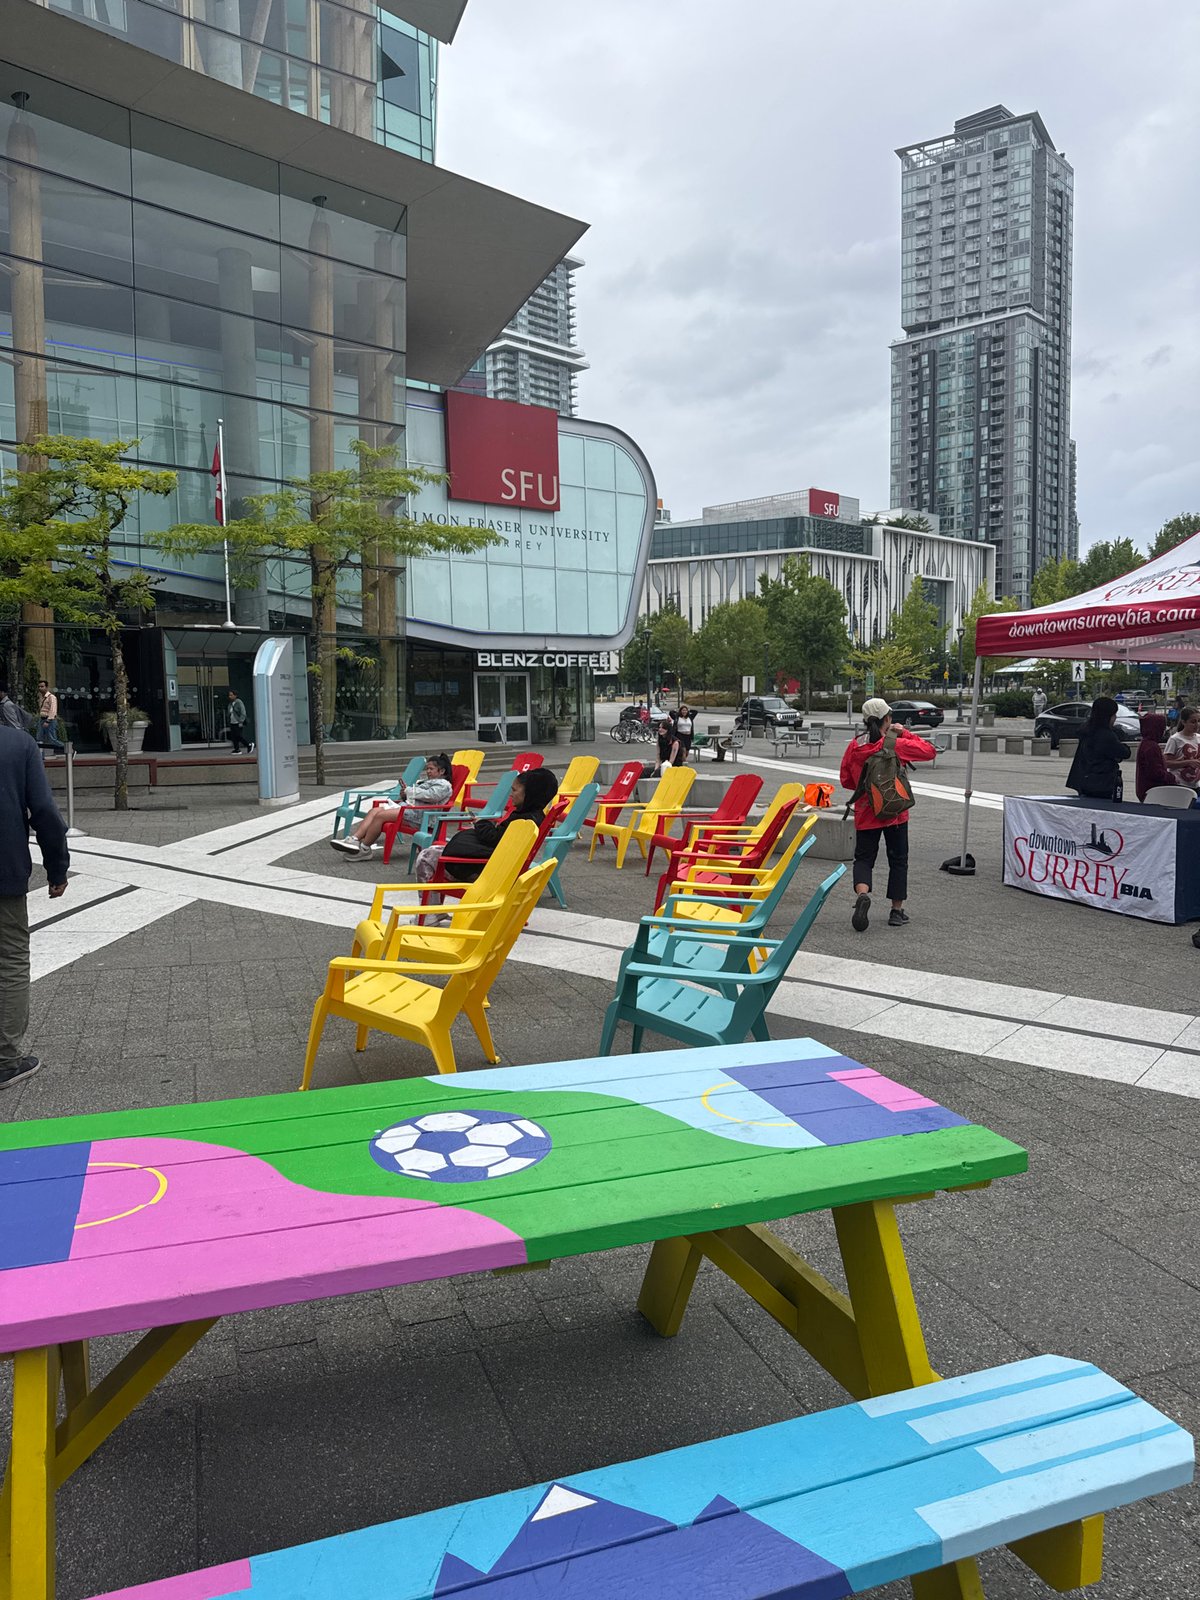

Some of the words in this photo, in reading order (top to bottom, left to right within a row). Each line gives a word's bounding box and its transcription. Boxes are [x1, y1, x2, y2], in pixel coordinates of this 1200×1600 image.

[501, 468, 558, 505] SFU
[823, 502, 840, 517] SFU
[402, 510, 460, 526] SIMON
[468, 516, 521, 534] FRASER
[529, 524, 610, 542] UNIVERSITY
[1008, 607, 1197, 638] downtownsurreybia.com
[477, 652, 539, 667] BLENZ
[1029, 829, 1077, 856] downtown
[1014, 836, 1129, 900] SURREY
[1120, 883, 1154, 900] BIA
